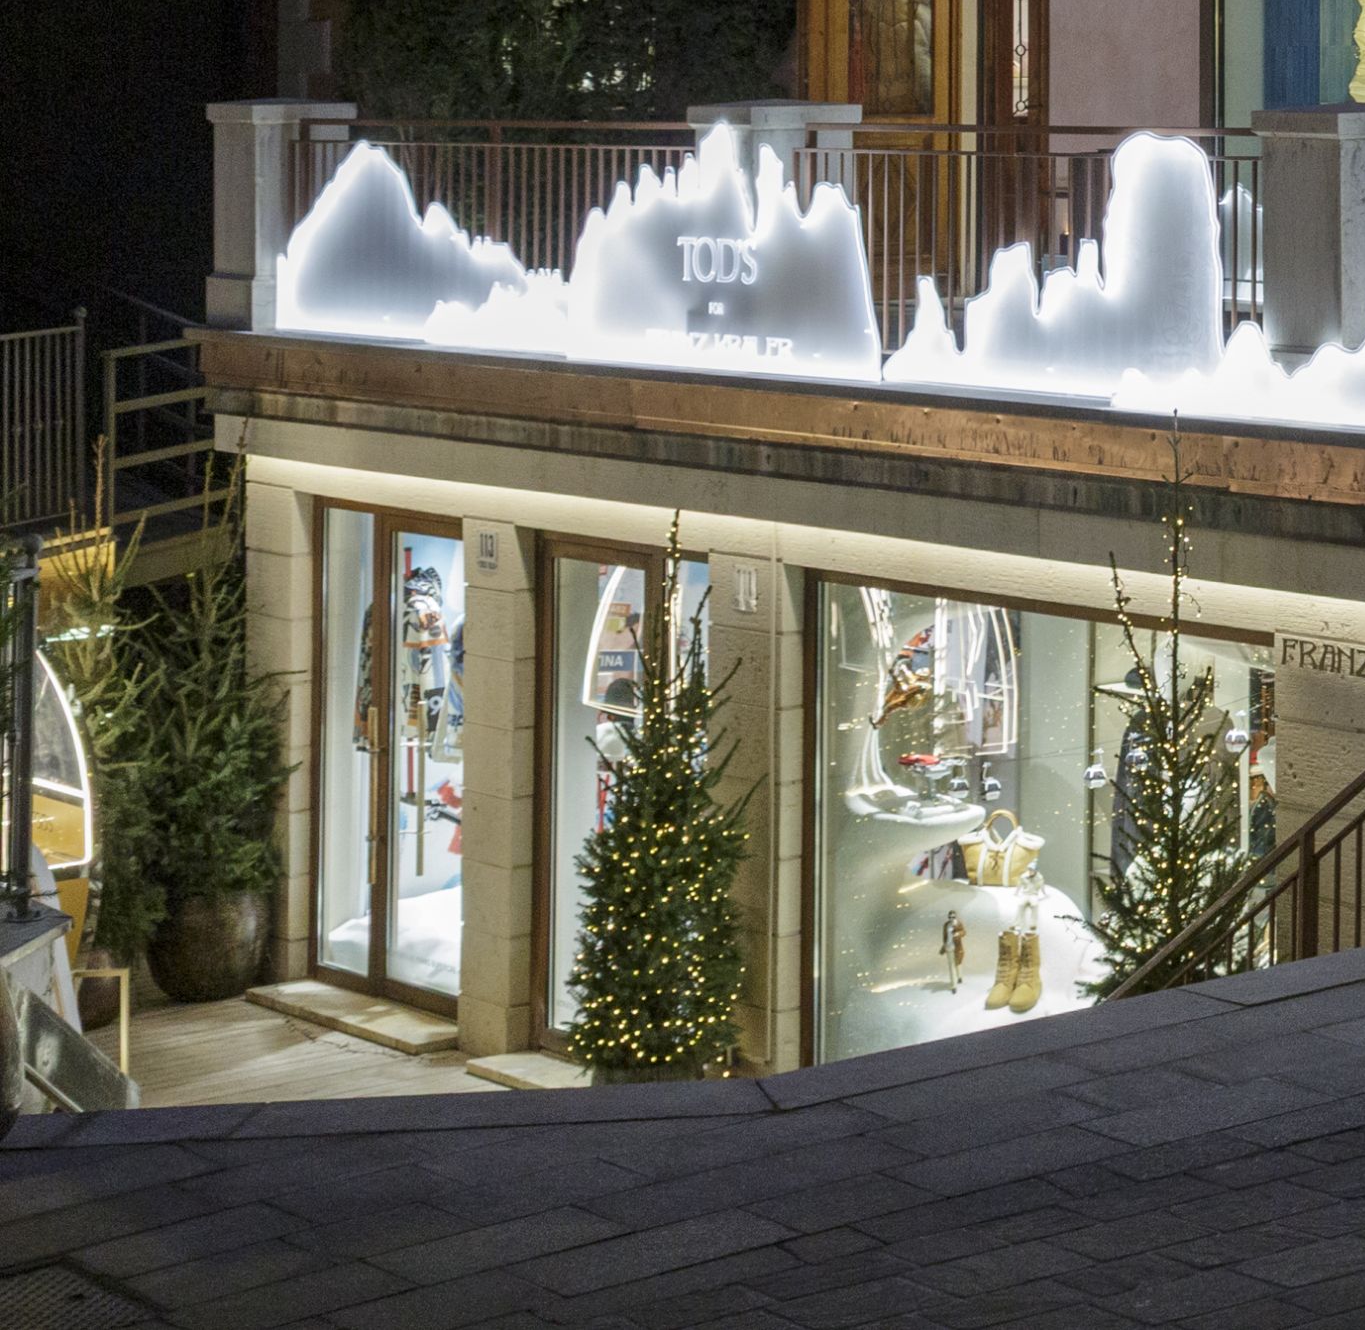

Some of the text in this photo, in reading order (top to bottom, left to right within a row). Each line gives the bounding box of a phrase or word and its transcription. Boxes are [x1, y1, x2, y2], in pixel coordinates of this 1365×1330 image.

[677, 236, 758, 286] TOD'S
[708, 302, 725, 315] FOR
[480, 533, 494, 558] 113
[598, 655, 625, 668] INA
